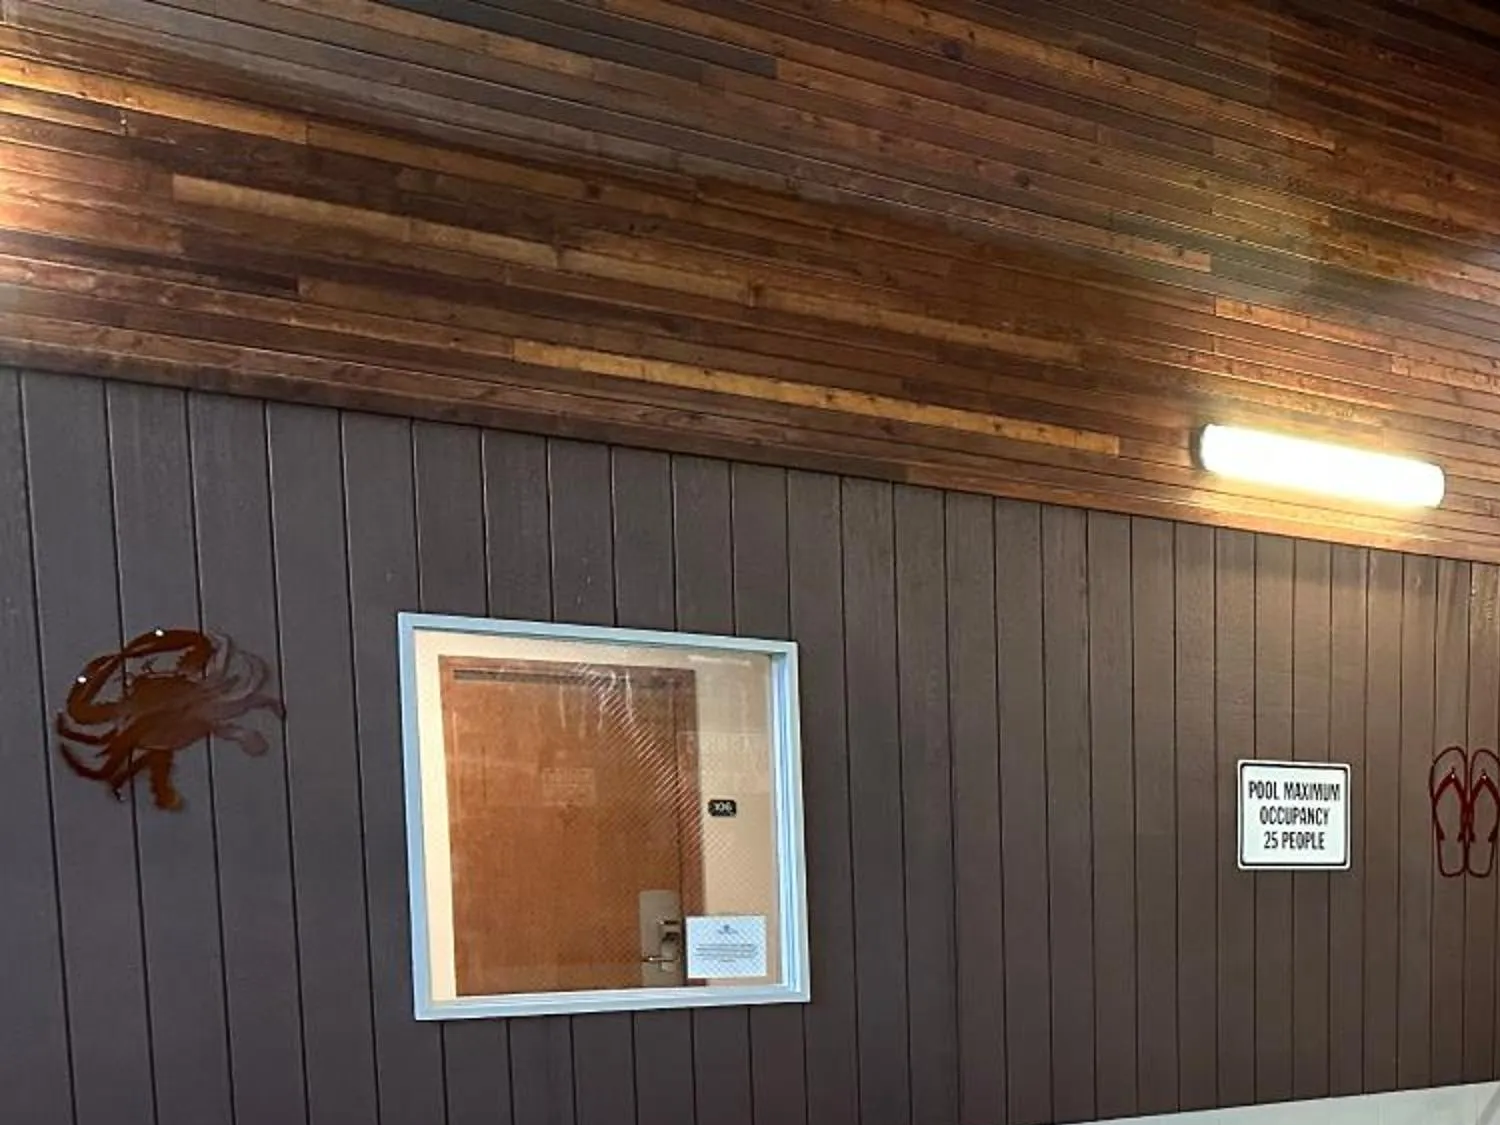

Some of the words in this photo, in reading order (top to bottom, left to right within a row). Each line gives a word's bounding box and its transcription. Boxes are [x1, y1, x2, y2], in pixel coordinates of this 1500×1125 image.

[1248, 781, 1279, 799] POOL
[1284, 782, 1340, 801] MAXIMUM
[1260, 806, 1330, 825] OCCUPANCY
[1264, 831, 1279, 849] 25
[1281, 831, 1325, 850] PEOPLE
